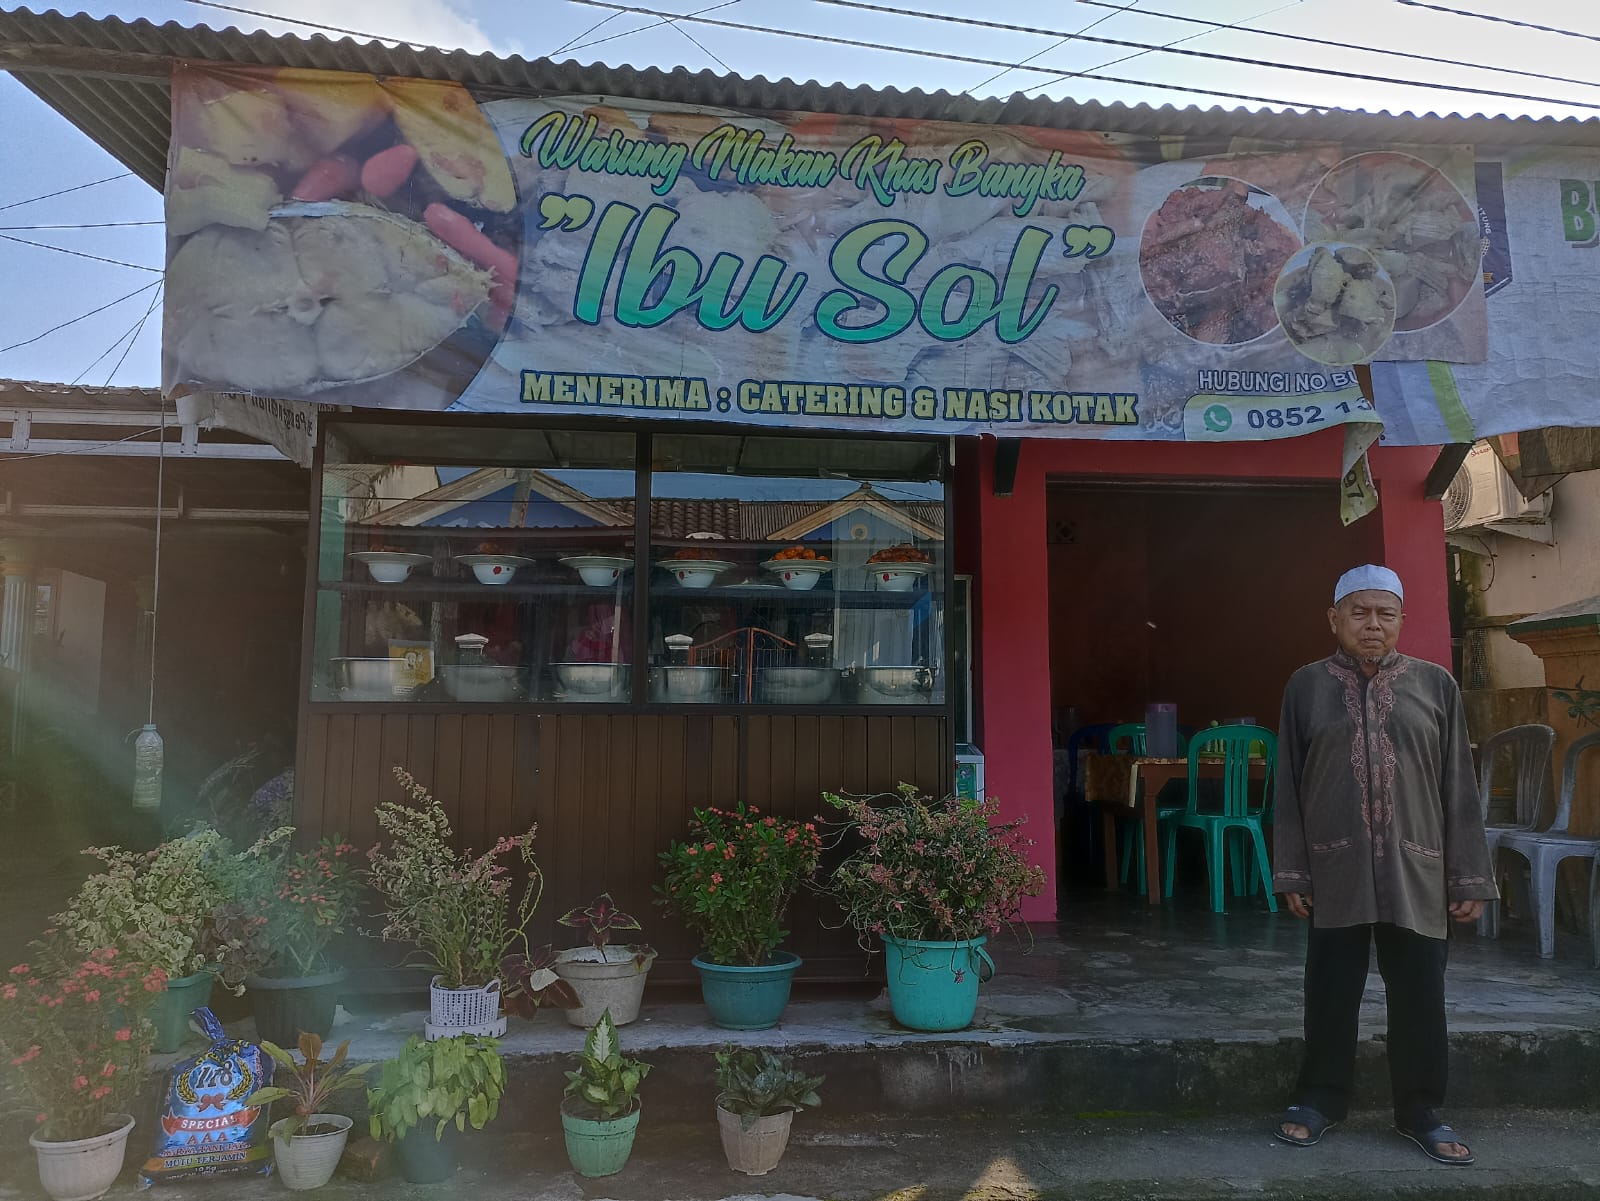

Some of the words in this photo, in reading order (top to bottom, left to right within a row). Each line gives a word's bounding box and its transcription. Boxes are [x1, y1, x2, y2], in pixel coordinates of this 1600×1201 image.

[520, 110, 689, 196] Warung
[691, 124, 838, 188] Makan
[838, 135, 942, 207] Khas
[943, 139, 1087, 217] Bangka
[1198, 370, 1291, 392] HUBUNGI
[1296, 372, 1327, 392] NO
[520, 369, 711, 412] MENERIMA
[737, 379, 906, 419] CATERING
[912, 386, 937, 420] &
[943, 388, 1022, 422] NASI
[1028, 391, 1139, 425] KOTAK
[1247, 405, 1326, 429] 0852
[196, 1151, 247, 1165] TERJAMIN
